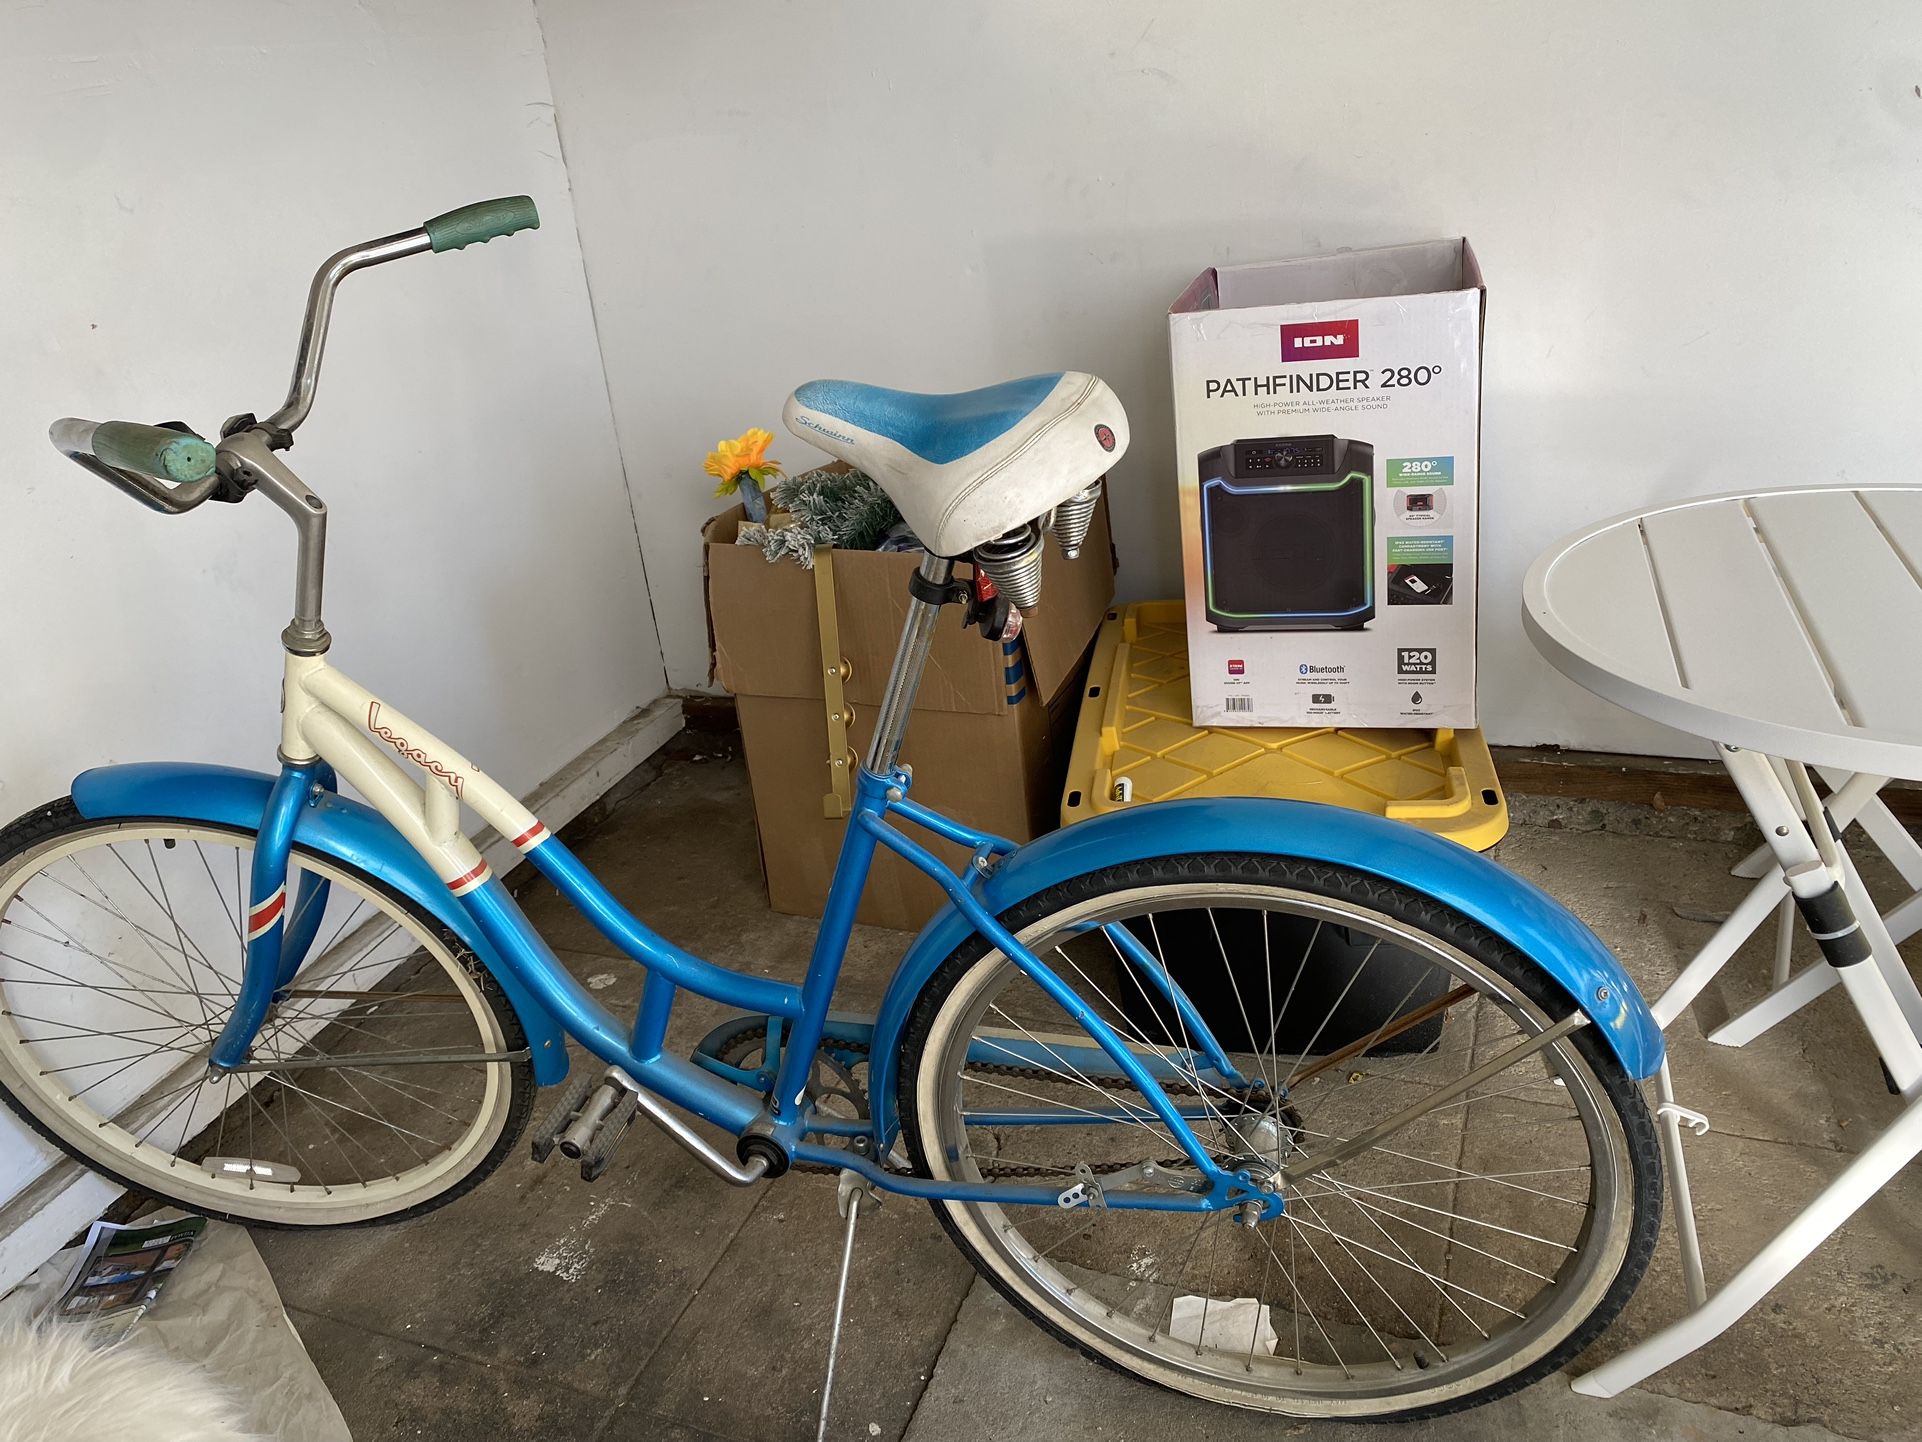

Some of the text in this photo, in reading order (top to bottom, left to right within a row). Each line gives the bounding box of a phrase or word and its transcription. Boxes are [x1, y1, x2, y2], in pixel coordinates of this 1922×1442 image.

[1294, 334, 1345, 348] ION
[1205, 369, 1371, 399] PATHFINDER
[1253, 395, 1391, 409] HIGH-POWER ALL-WEATHER SPEAKER
[1277, 407, 1310, 415] PREMIUM
[1311, 405, 1359, 413] WIDE-ANGLE
[1361, 403, 1388, 411] SOUND
[795, 415, 856, 446] Schwinn
[1402, 651, 1432, 663] 120
[1309, 665, 1345, 674] Bluetooth
